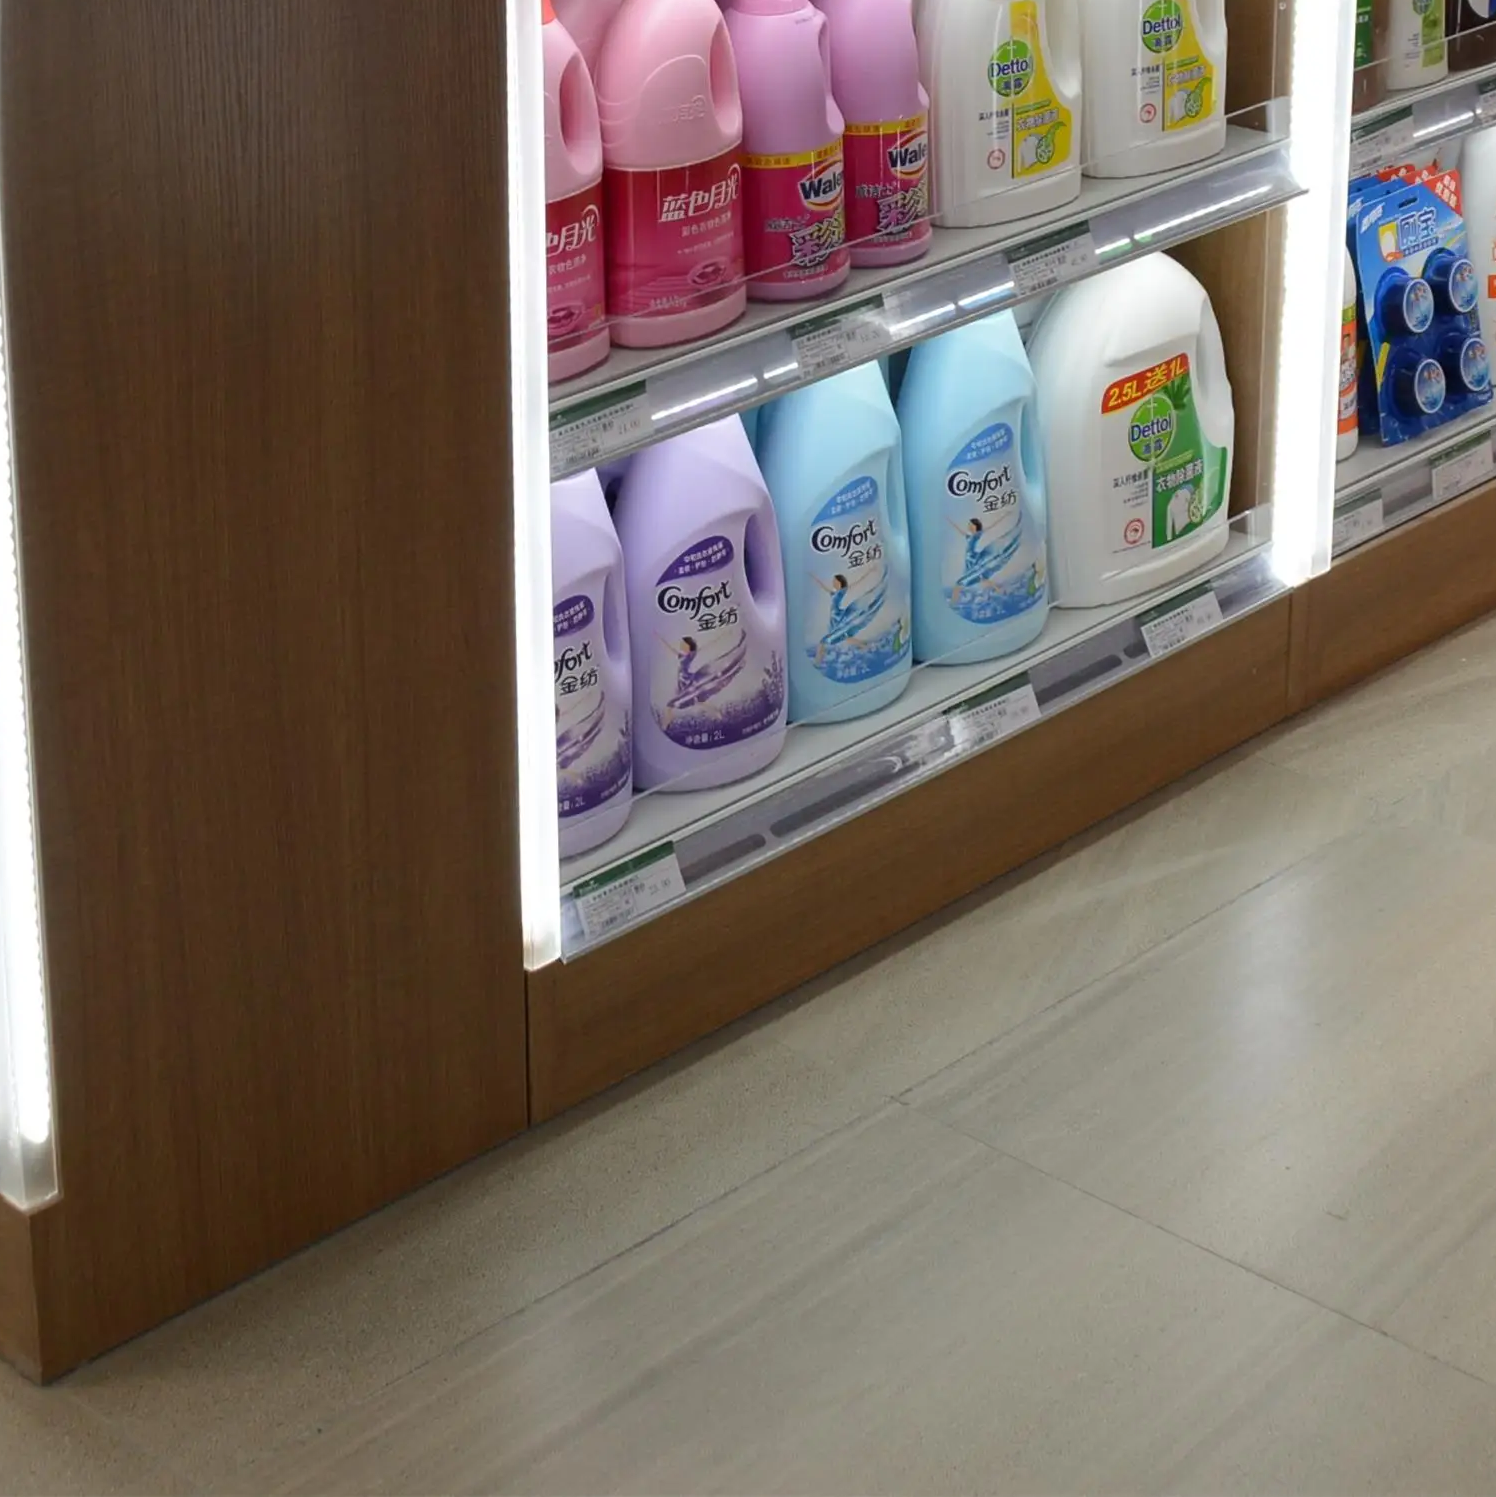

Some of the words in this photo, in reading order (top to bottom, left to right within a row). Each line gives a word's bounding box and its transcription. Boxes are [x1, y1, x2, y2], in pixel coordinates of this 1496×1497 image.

[1143, 14, 1181, 35] Dettol
[659, 163, 742, 223] 蓝色月光
[1131, 412, 1172, 442] Dettol
[948, 465, 1011, 501] Comfort
[983, 489, 1017, 513] 金纺
[811, 519, 877, 557] Comfort
[848, 543, 882, 569] 金纺
[657, 581, 732, 620] Comfort
[698, 608, 739, 632] 金纺
[560, 668, 598, 696] 金纺
